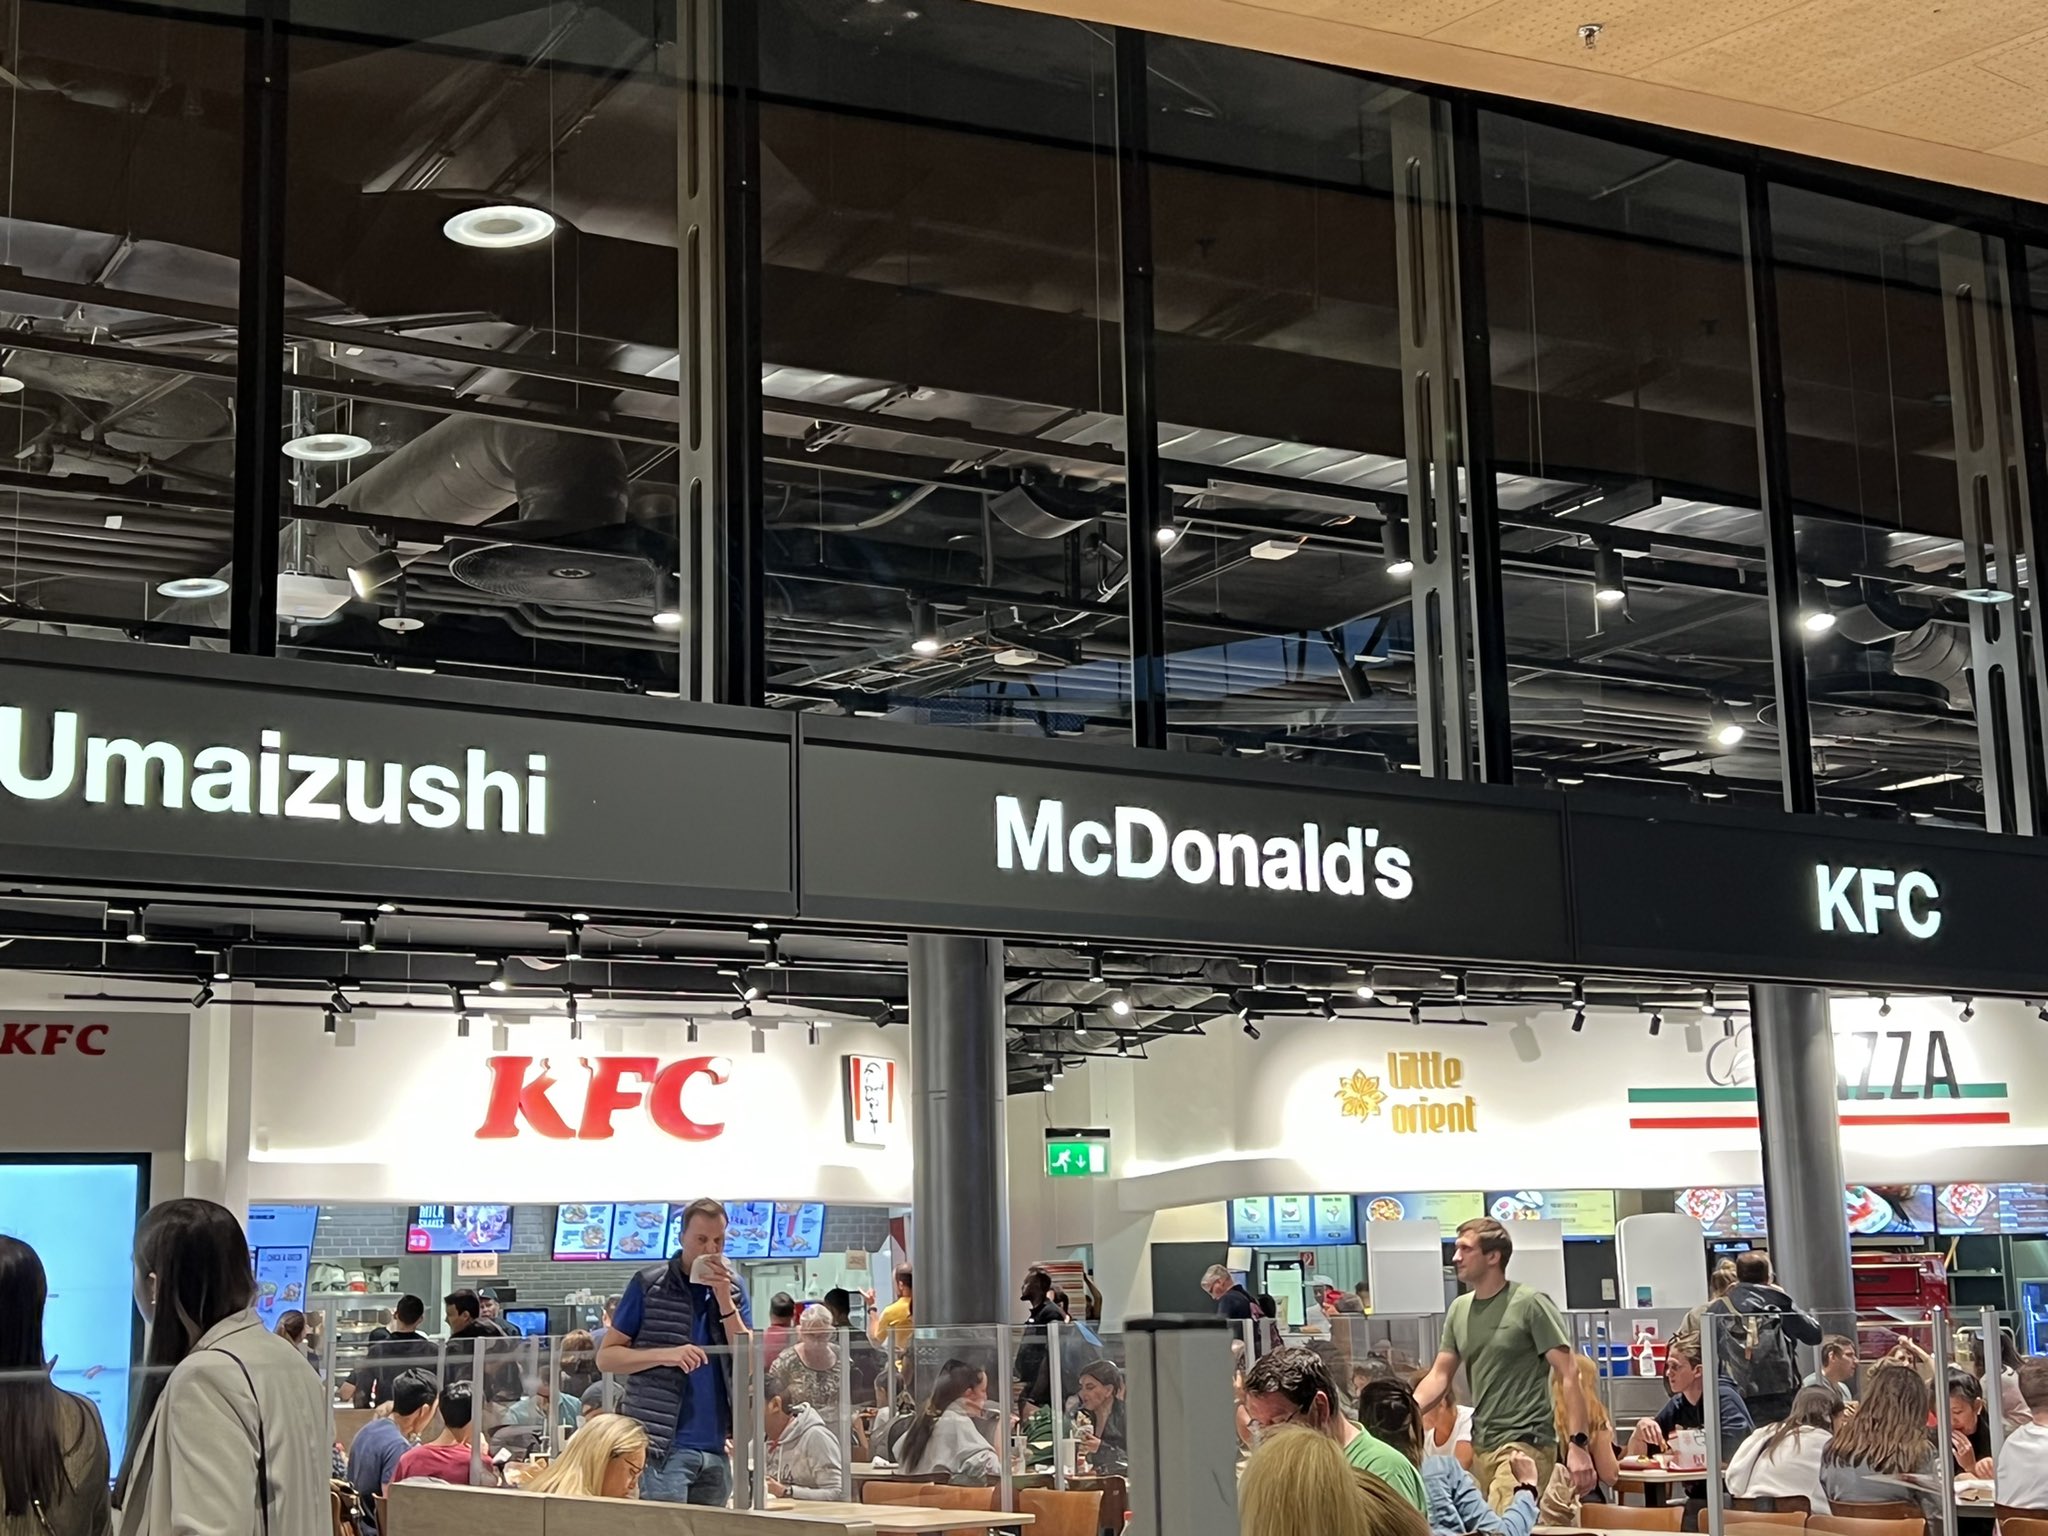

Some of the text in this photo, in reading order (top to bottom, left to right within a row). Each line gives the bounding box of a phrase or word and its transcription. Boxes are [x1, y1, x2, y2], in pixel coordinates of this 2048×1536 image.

[0, 706, 547, 835] Umaizushi
[995, 795, 1413, 900] McDonald's
[1816, 864, 1942, 939] KFC
[0, 1023, 109, 1056] KFC
[1832, 1031, 1961, 1100] ZZA
[474, 1056, 732, 1142] KFC
[461, 1259, 481, 1270] PICK
